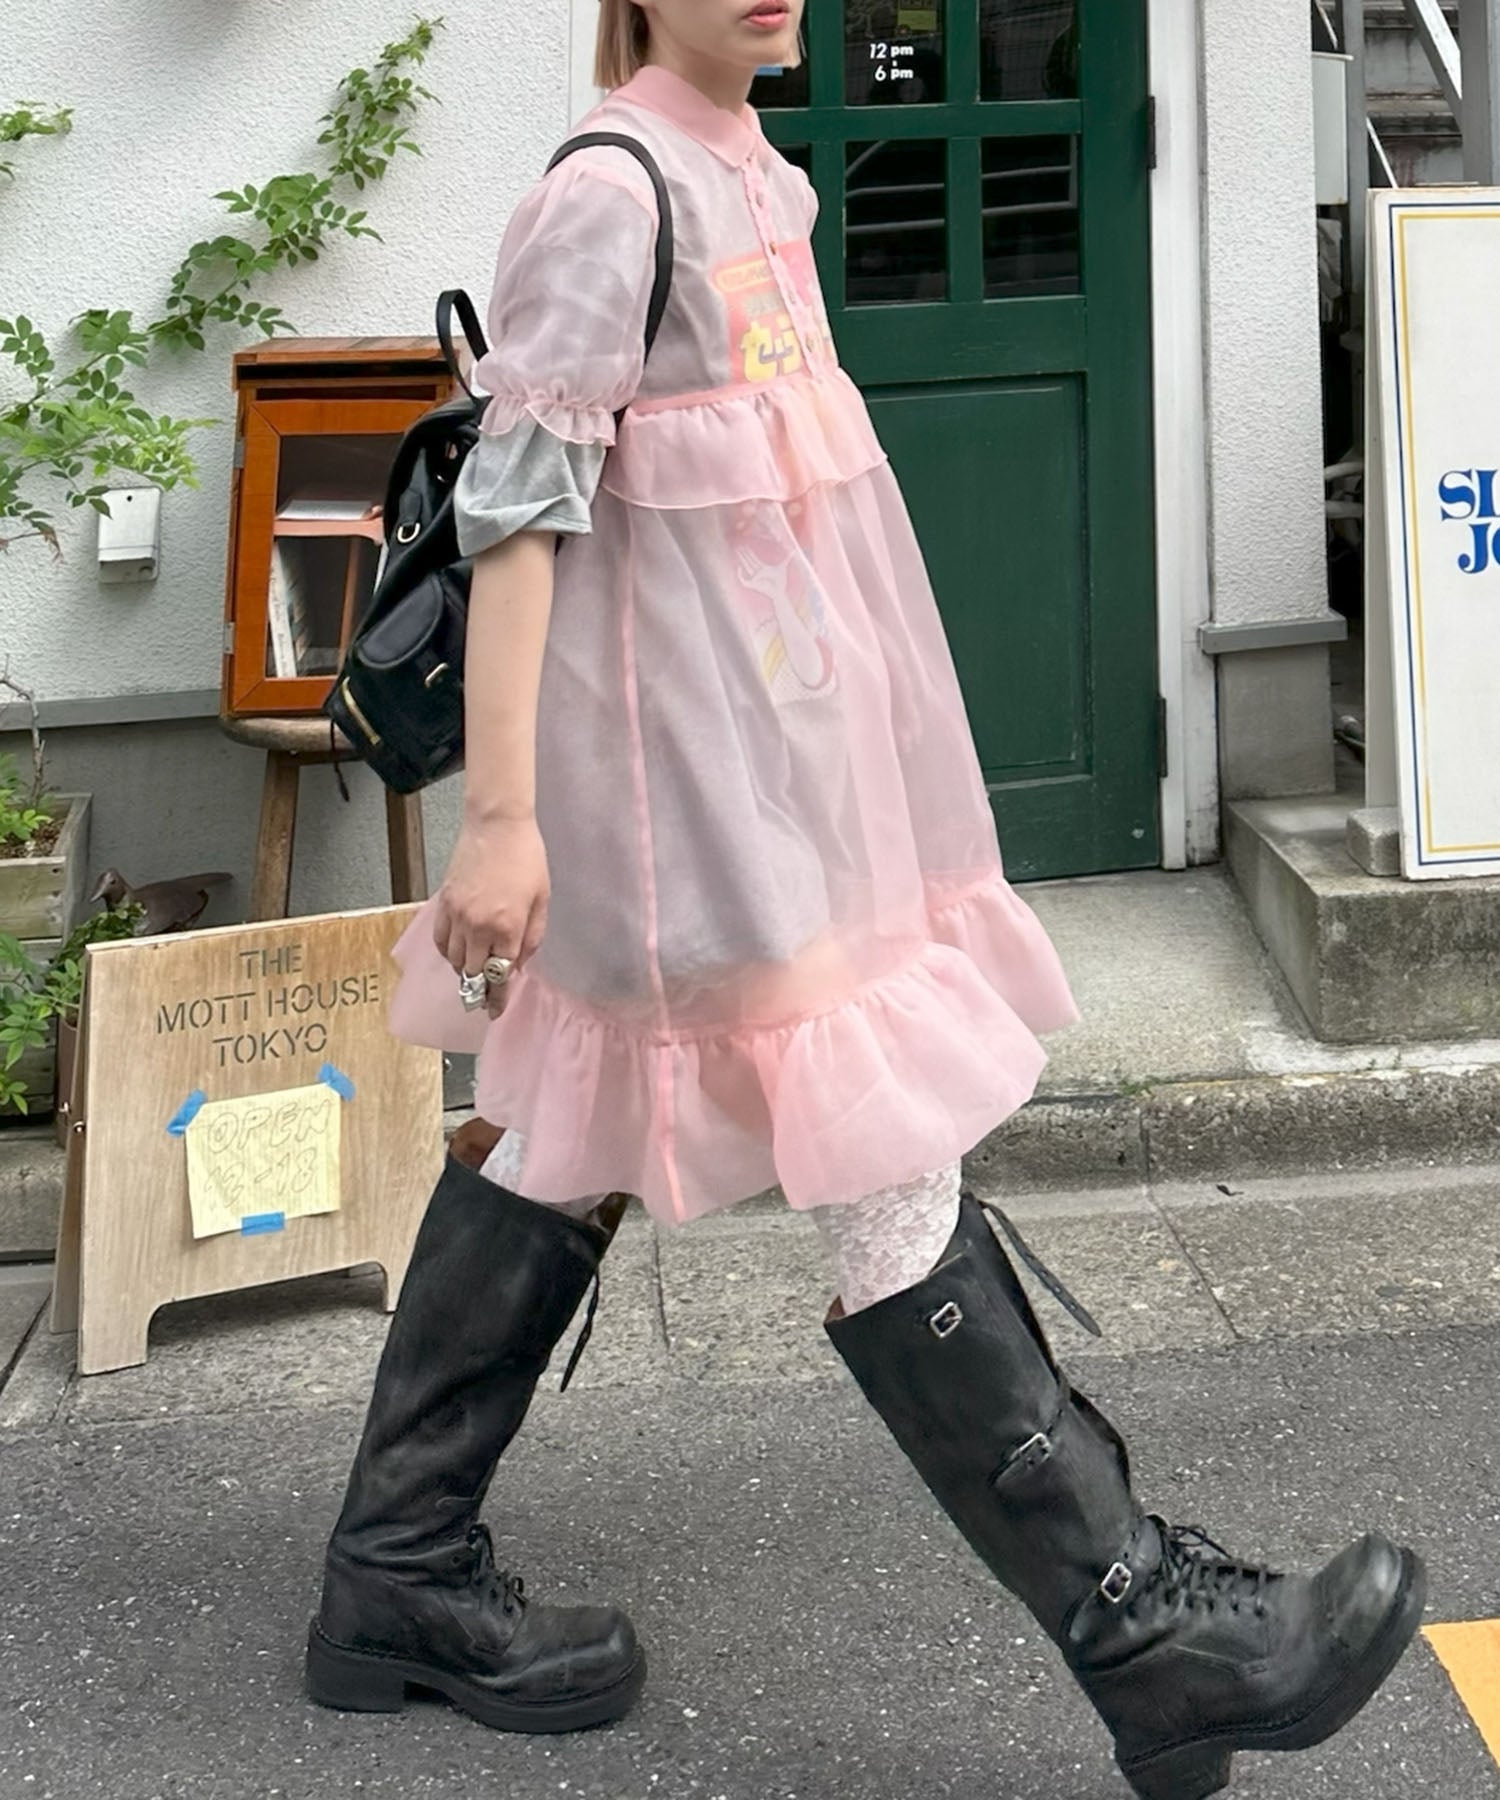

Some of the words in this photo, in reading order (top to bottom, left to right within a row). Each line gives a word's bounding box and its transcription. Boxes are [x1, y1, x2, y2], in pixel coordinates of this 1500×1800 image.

[869, 42, 888, 59] 12
[890, 45, 914, 58] pm
[874, 64, 887, 82] 6
[890, 68, 914, 81] pm
[1457, 522, 1500, 574] J
[239, 944, 303, 979] THE
[156, 992, 256, 1034] MOTT
[267, 974, 380, 1018] HOUSE
[212, 1022, 328, 1067] TOKYO
[207, 1098, 330, 1154] OPEN
